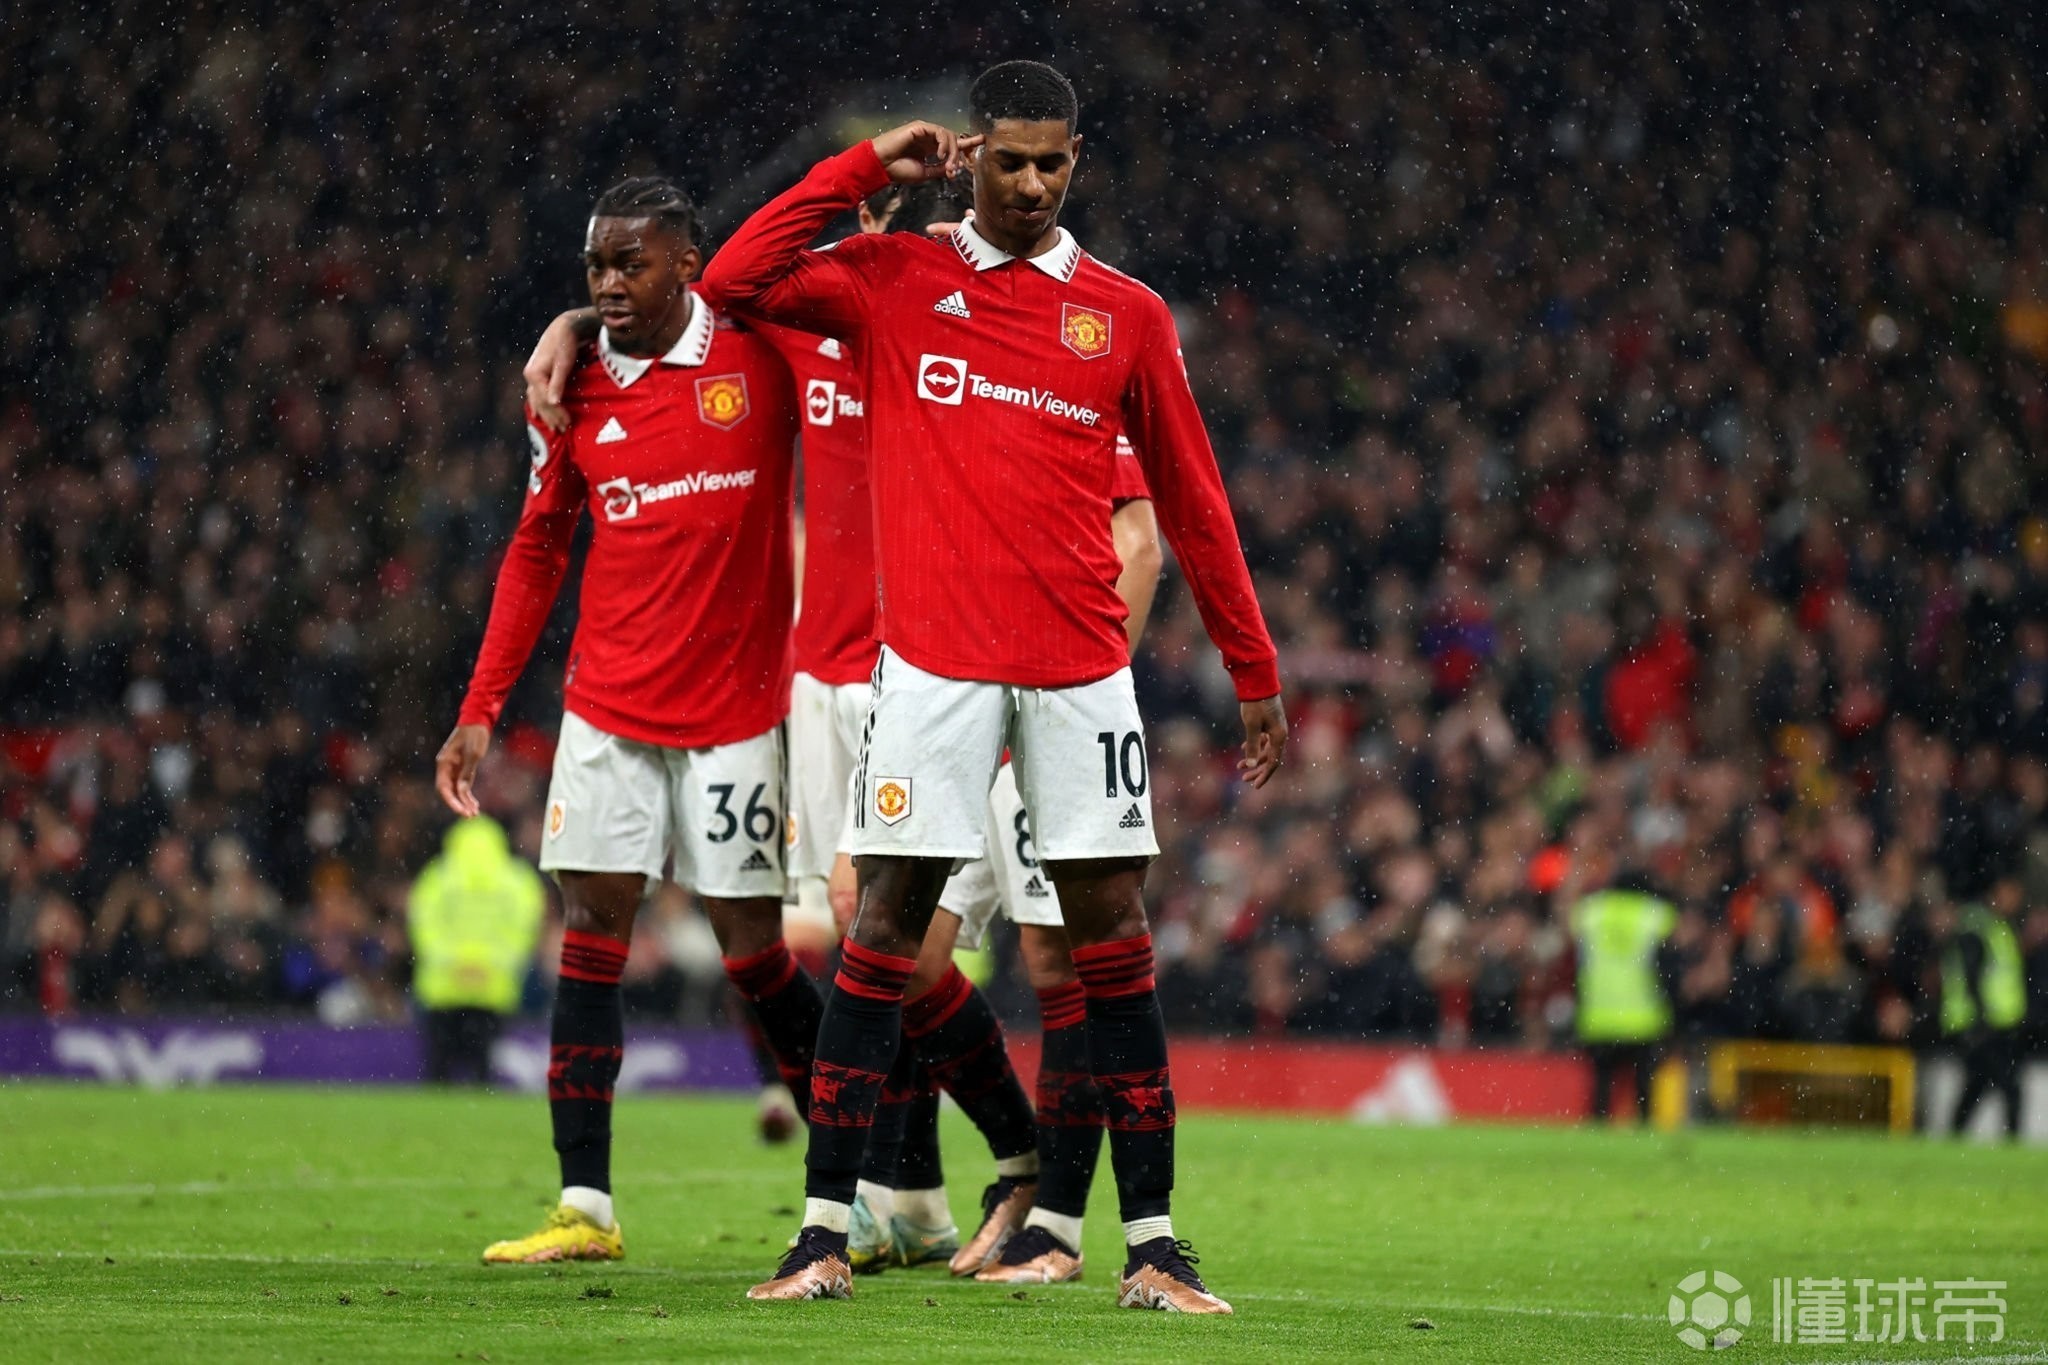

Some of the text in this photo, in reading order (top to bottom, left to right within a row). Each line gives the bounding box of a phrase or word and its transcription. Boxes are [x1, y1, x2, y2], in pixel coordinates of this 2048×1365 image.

[934, 303, 971, 319] adidas
[968, 374, 1100, 426] TeamViewer
[633, 469, 757, 504] TeamViewer
[1097, 731, 1146, 798] 10
[707, 783, 776, 843] 36
